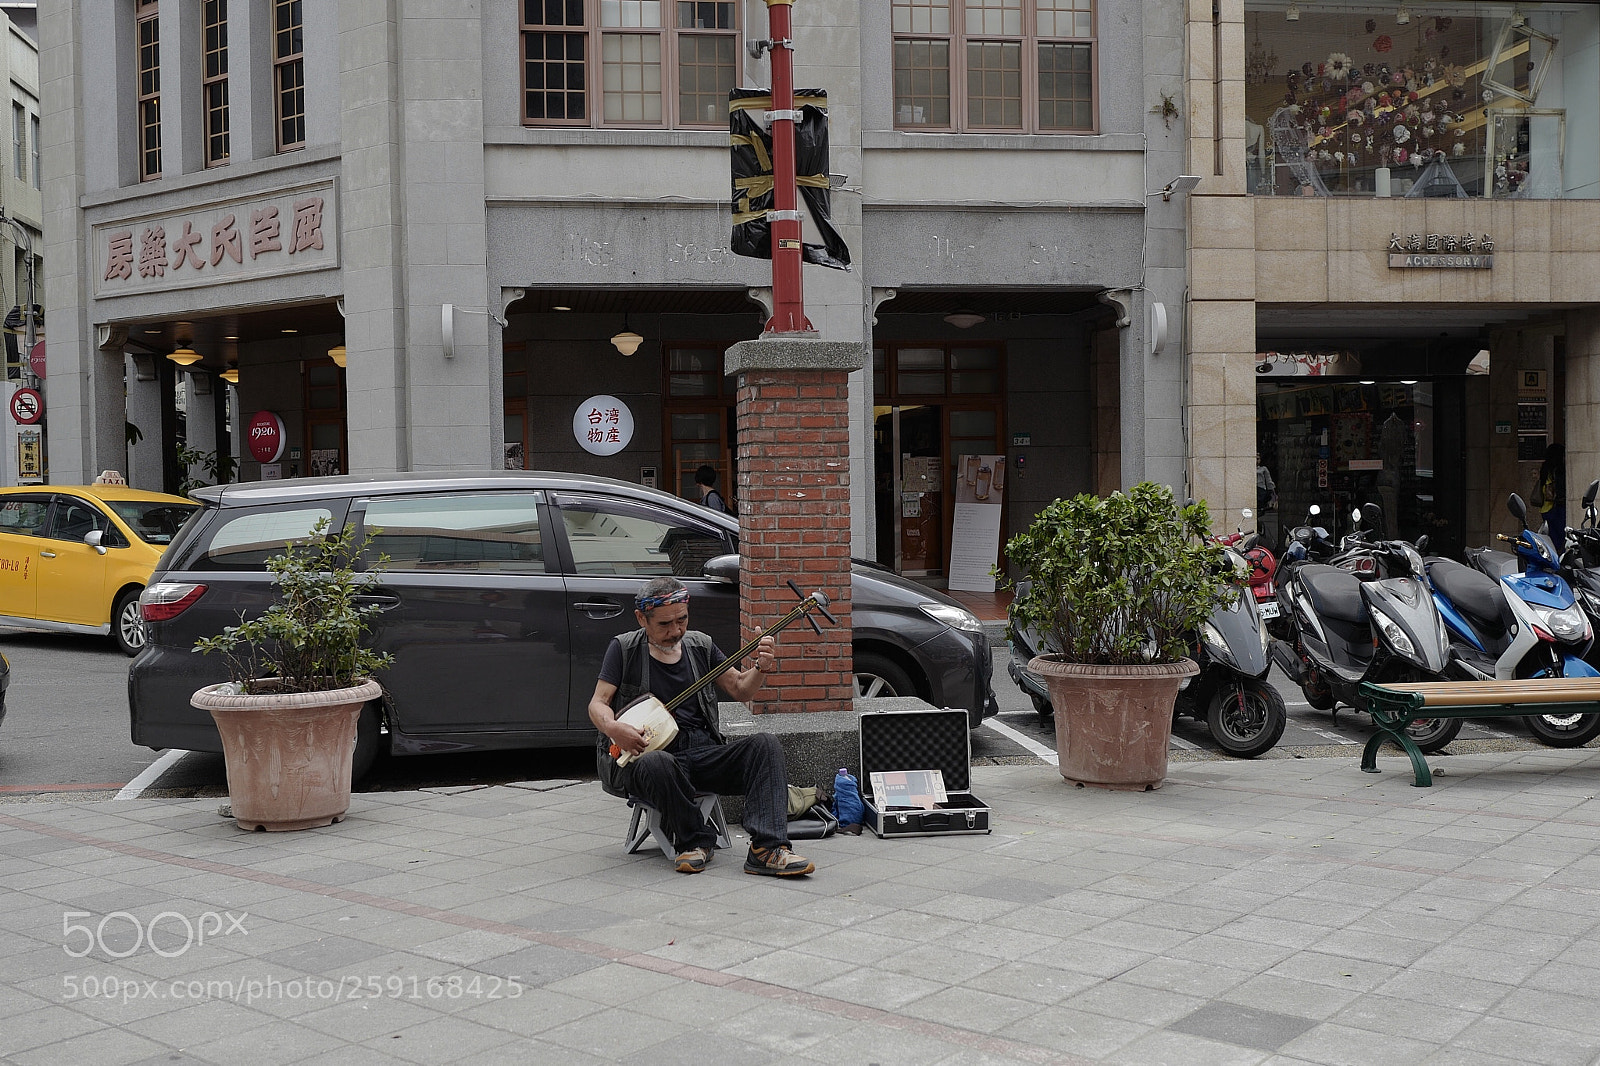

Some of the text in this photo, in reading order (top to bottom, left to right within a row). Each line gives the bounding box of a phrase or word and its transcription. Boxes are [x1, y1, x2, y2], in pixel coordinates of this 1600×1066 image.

[104, 198, 324, 281] 屈臣氏大藥房
